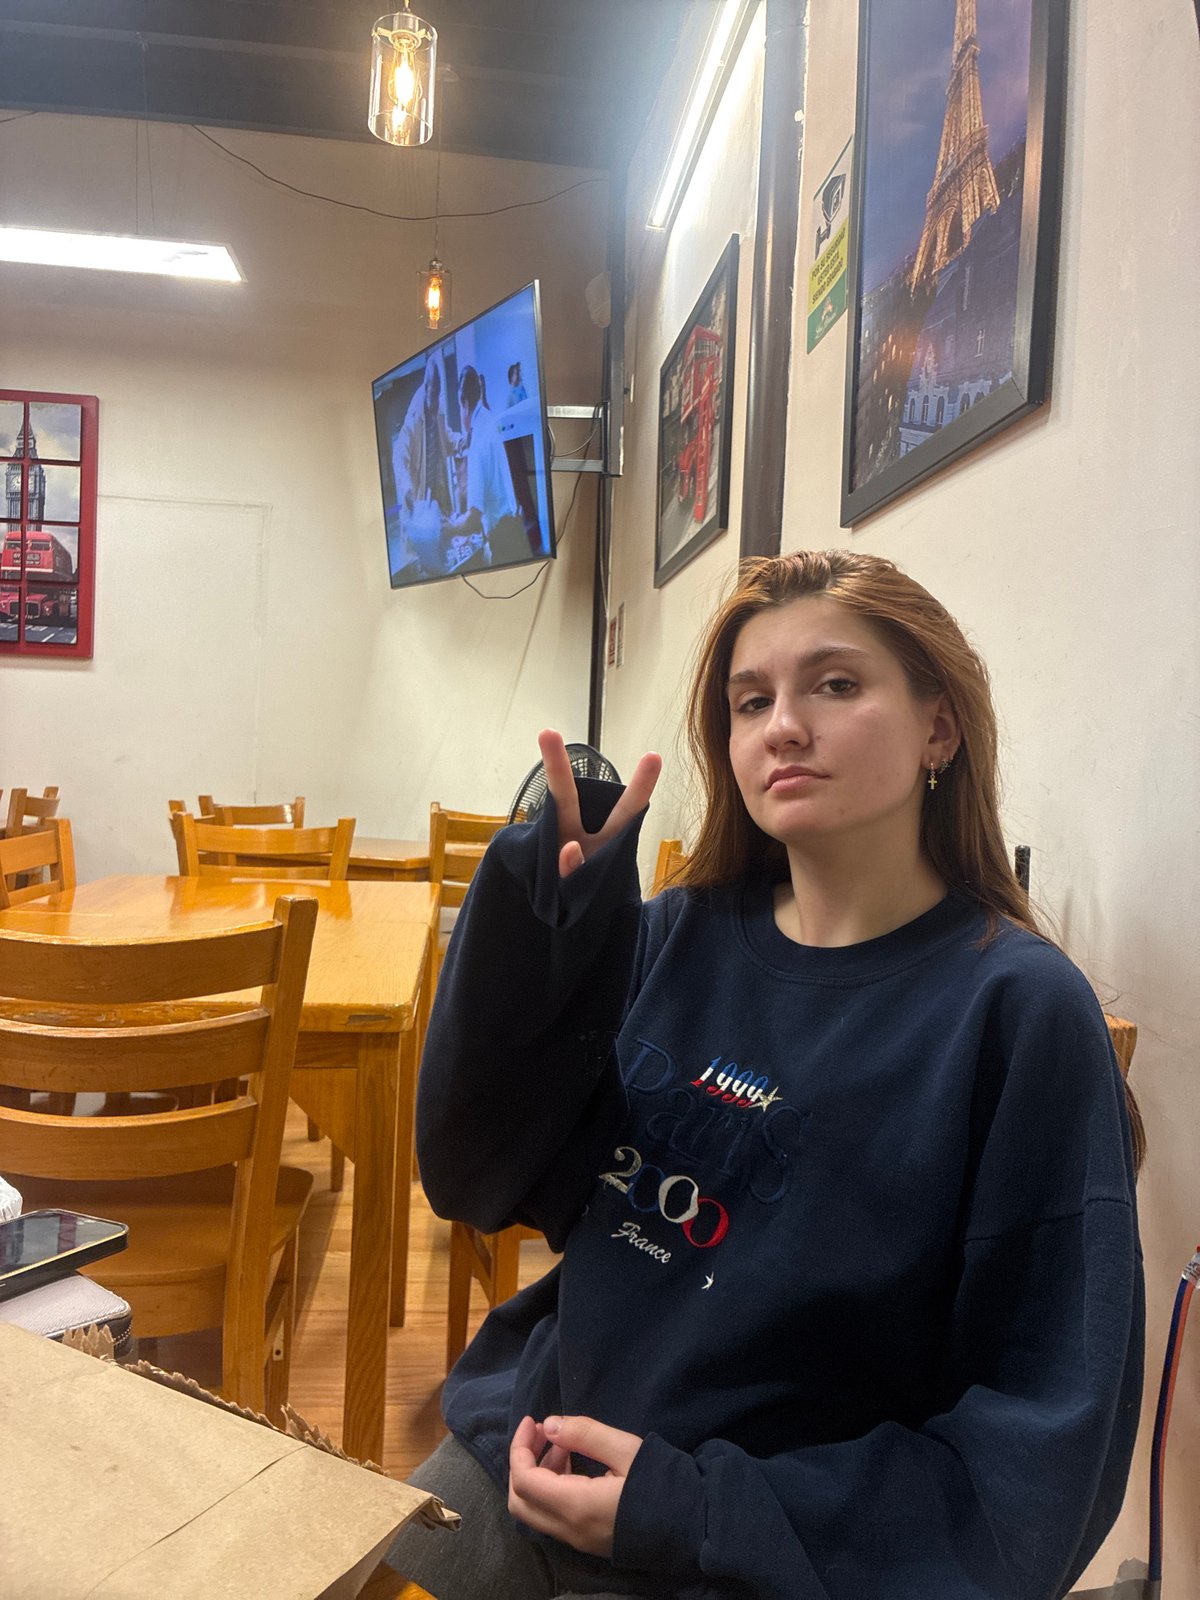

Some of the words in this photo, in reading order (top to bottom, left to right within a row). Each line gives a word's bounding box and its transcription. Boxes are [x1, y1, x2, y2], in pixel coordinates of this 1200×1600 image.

[690, 1056, 769, 1108] 1999
[599, 1145, 730, 1249] 2000
[611, 1220, 672, 1264] France
